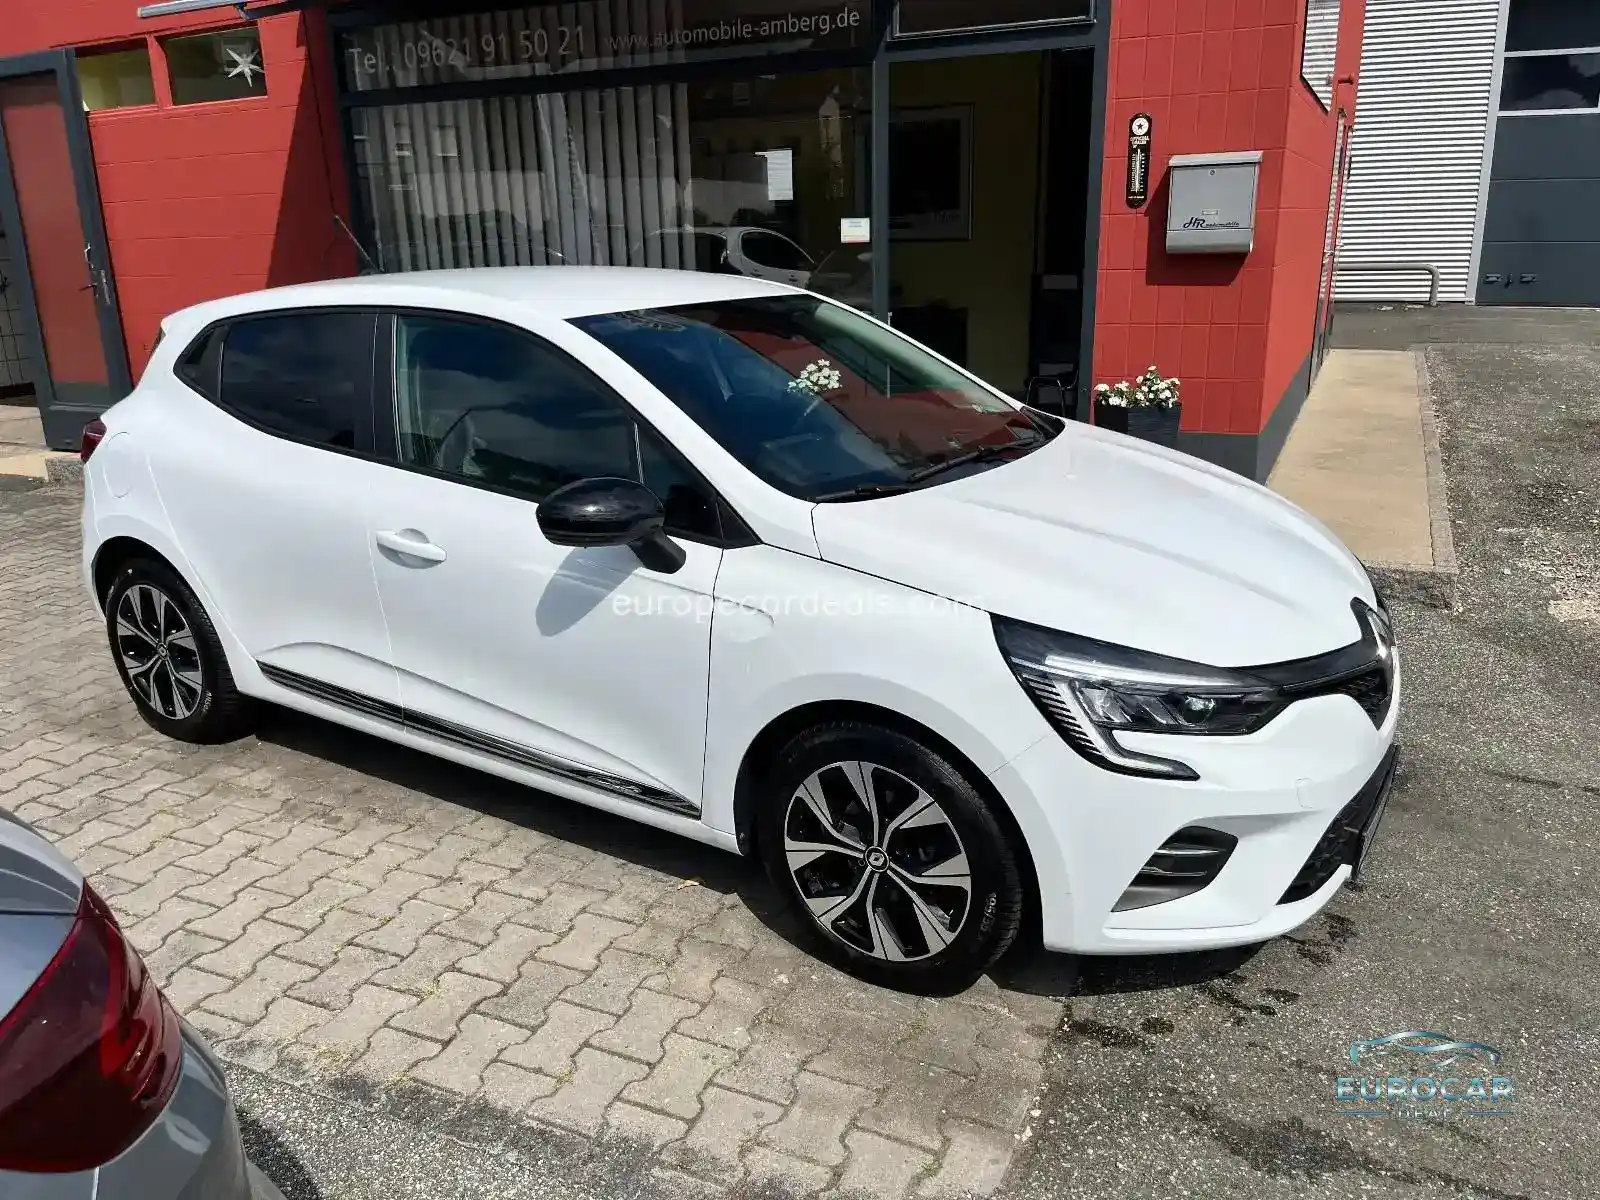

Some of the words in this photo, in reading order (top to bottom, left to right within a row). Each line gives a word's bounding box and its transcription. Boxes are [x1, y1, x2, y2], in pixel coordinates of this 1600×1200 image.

[403, 38, 471, 69] 09621
[481, 32, 507, 61] 91
[520, 28, 548, 58] 50
[558, 25, 584, 55] 21
[606, 7, 861, 50] www.automobile-amberg.de
